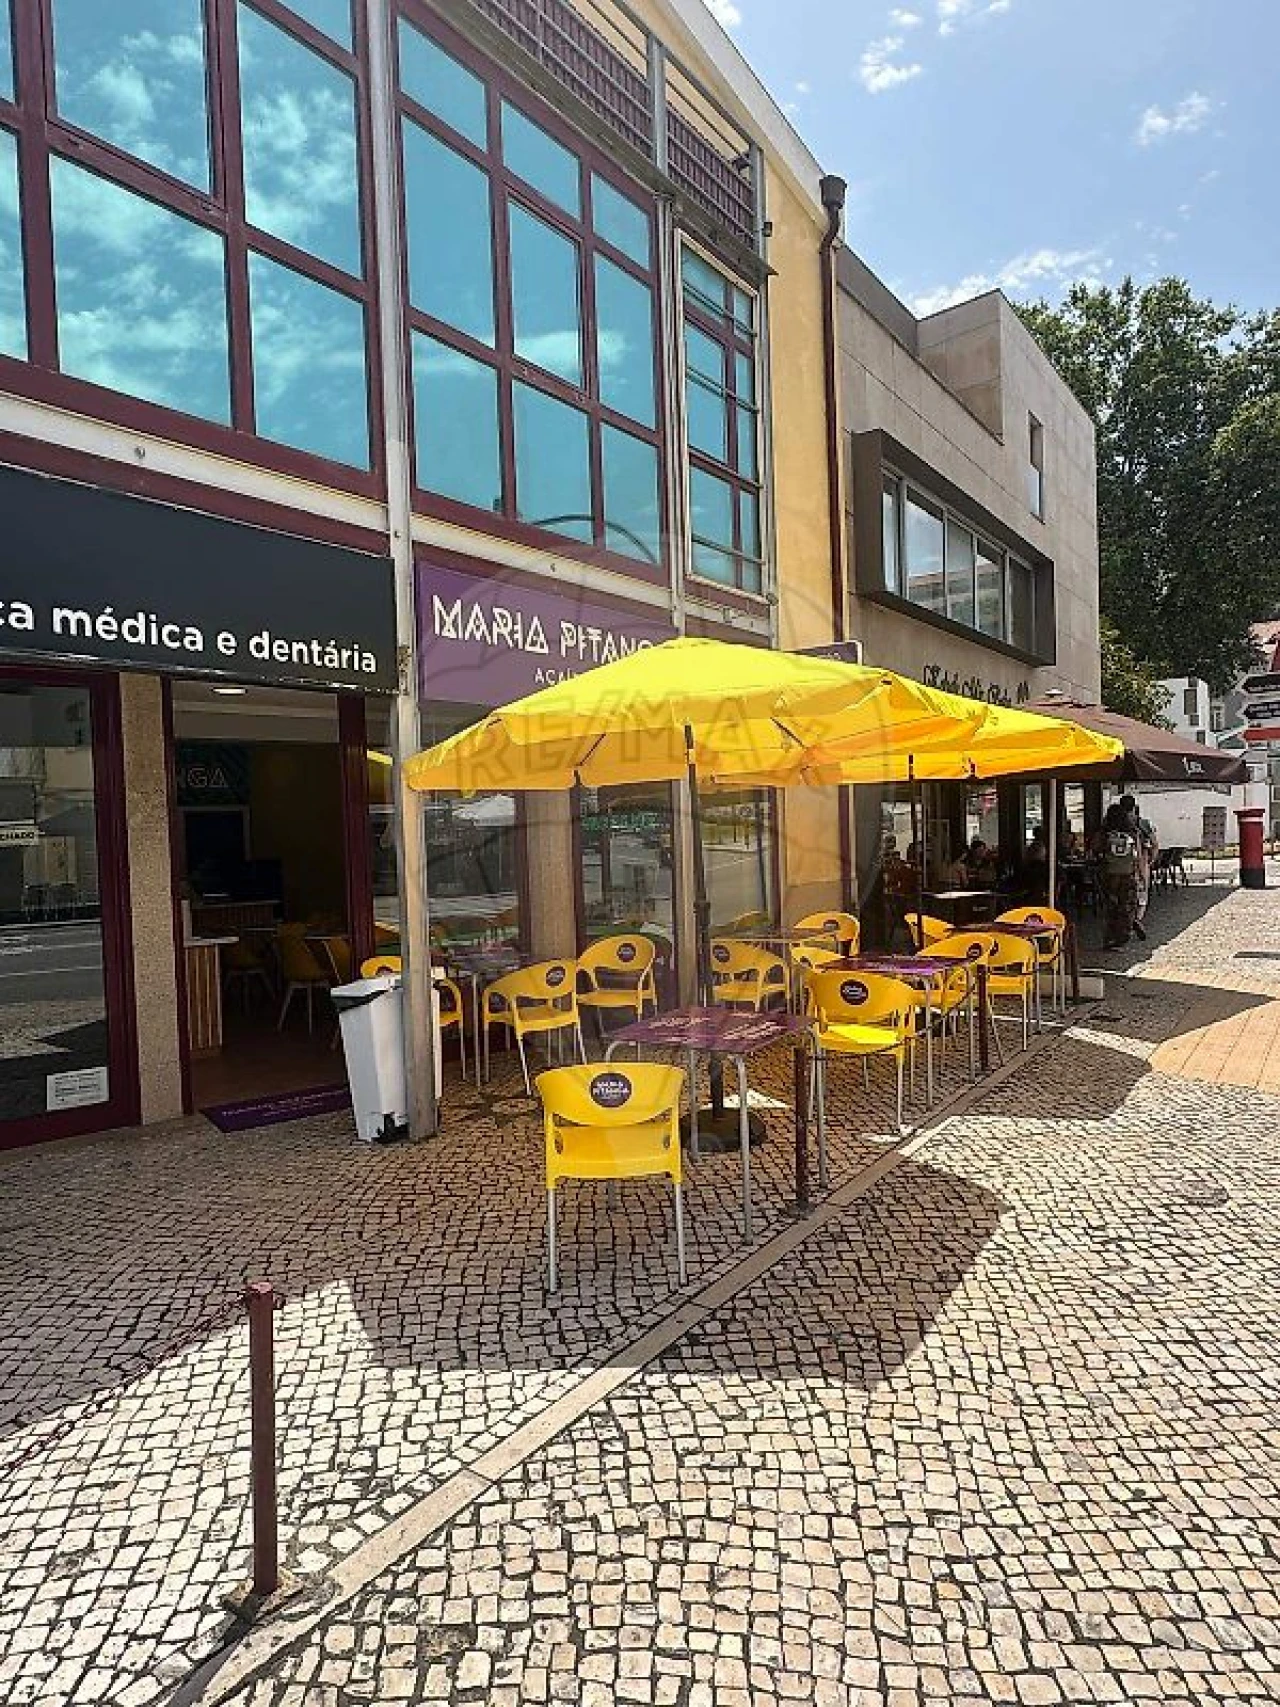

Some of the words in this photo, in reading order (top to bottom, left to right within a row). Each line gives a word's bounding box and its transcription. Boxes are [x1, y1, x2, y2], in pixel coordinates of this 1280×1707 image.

[52, 605, 204, 652] médica
[216, 630, 237, 656] e
[249, 630, 376, 673] dentária
[433, 594, 549, 654] MARIA
